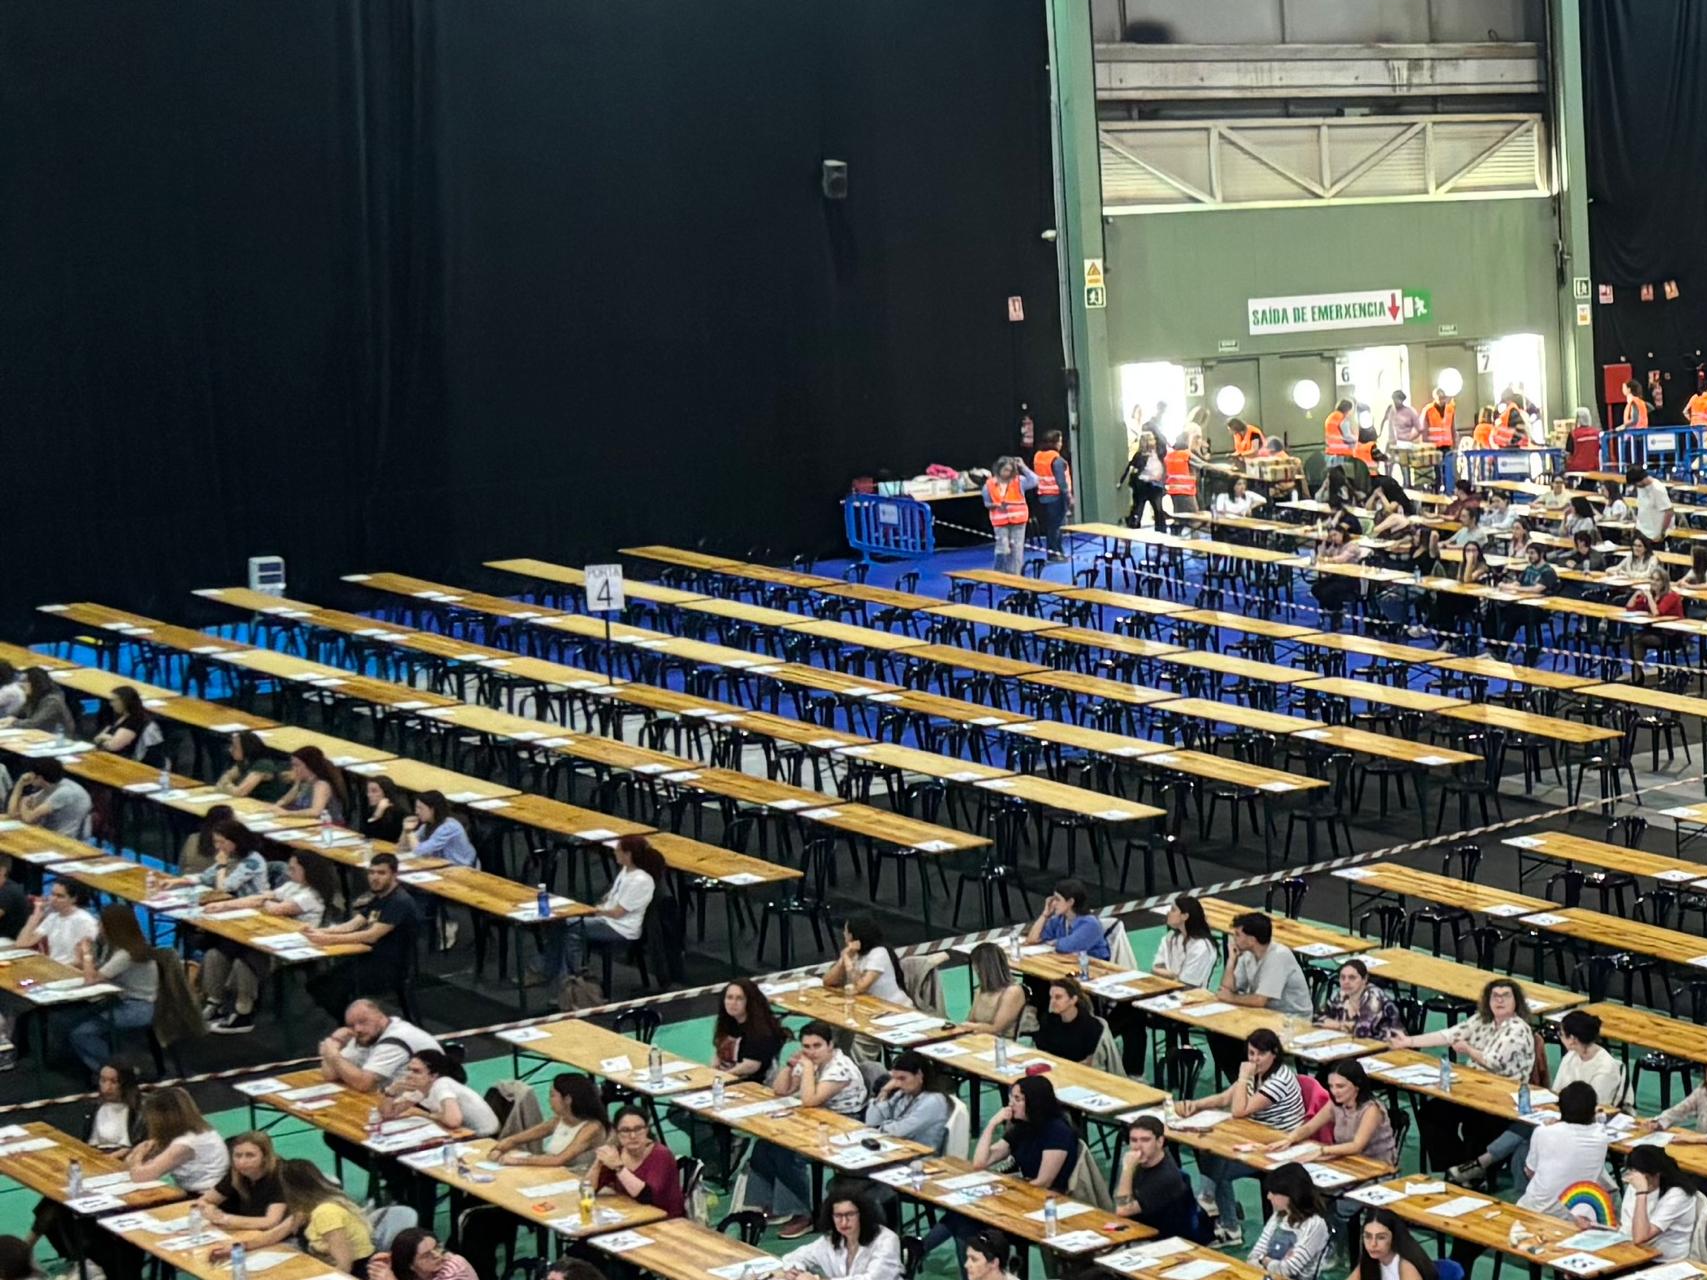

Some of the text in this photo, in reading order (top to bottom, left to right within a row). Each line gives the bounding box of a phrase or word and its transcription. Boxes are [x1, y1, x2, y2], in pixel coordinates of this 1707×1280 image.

[1252, 301, 1386, 326] SAÍDA DE EMERXENCIA
[1481, 354, 1490, 371] 7
[1341, 366, 1350, 383] 6
[1189, 376, 1198, 394] 5
[597, 578, 613, 608] 4
